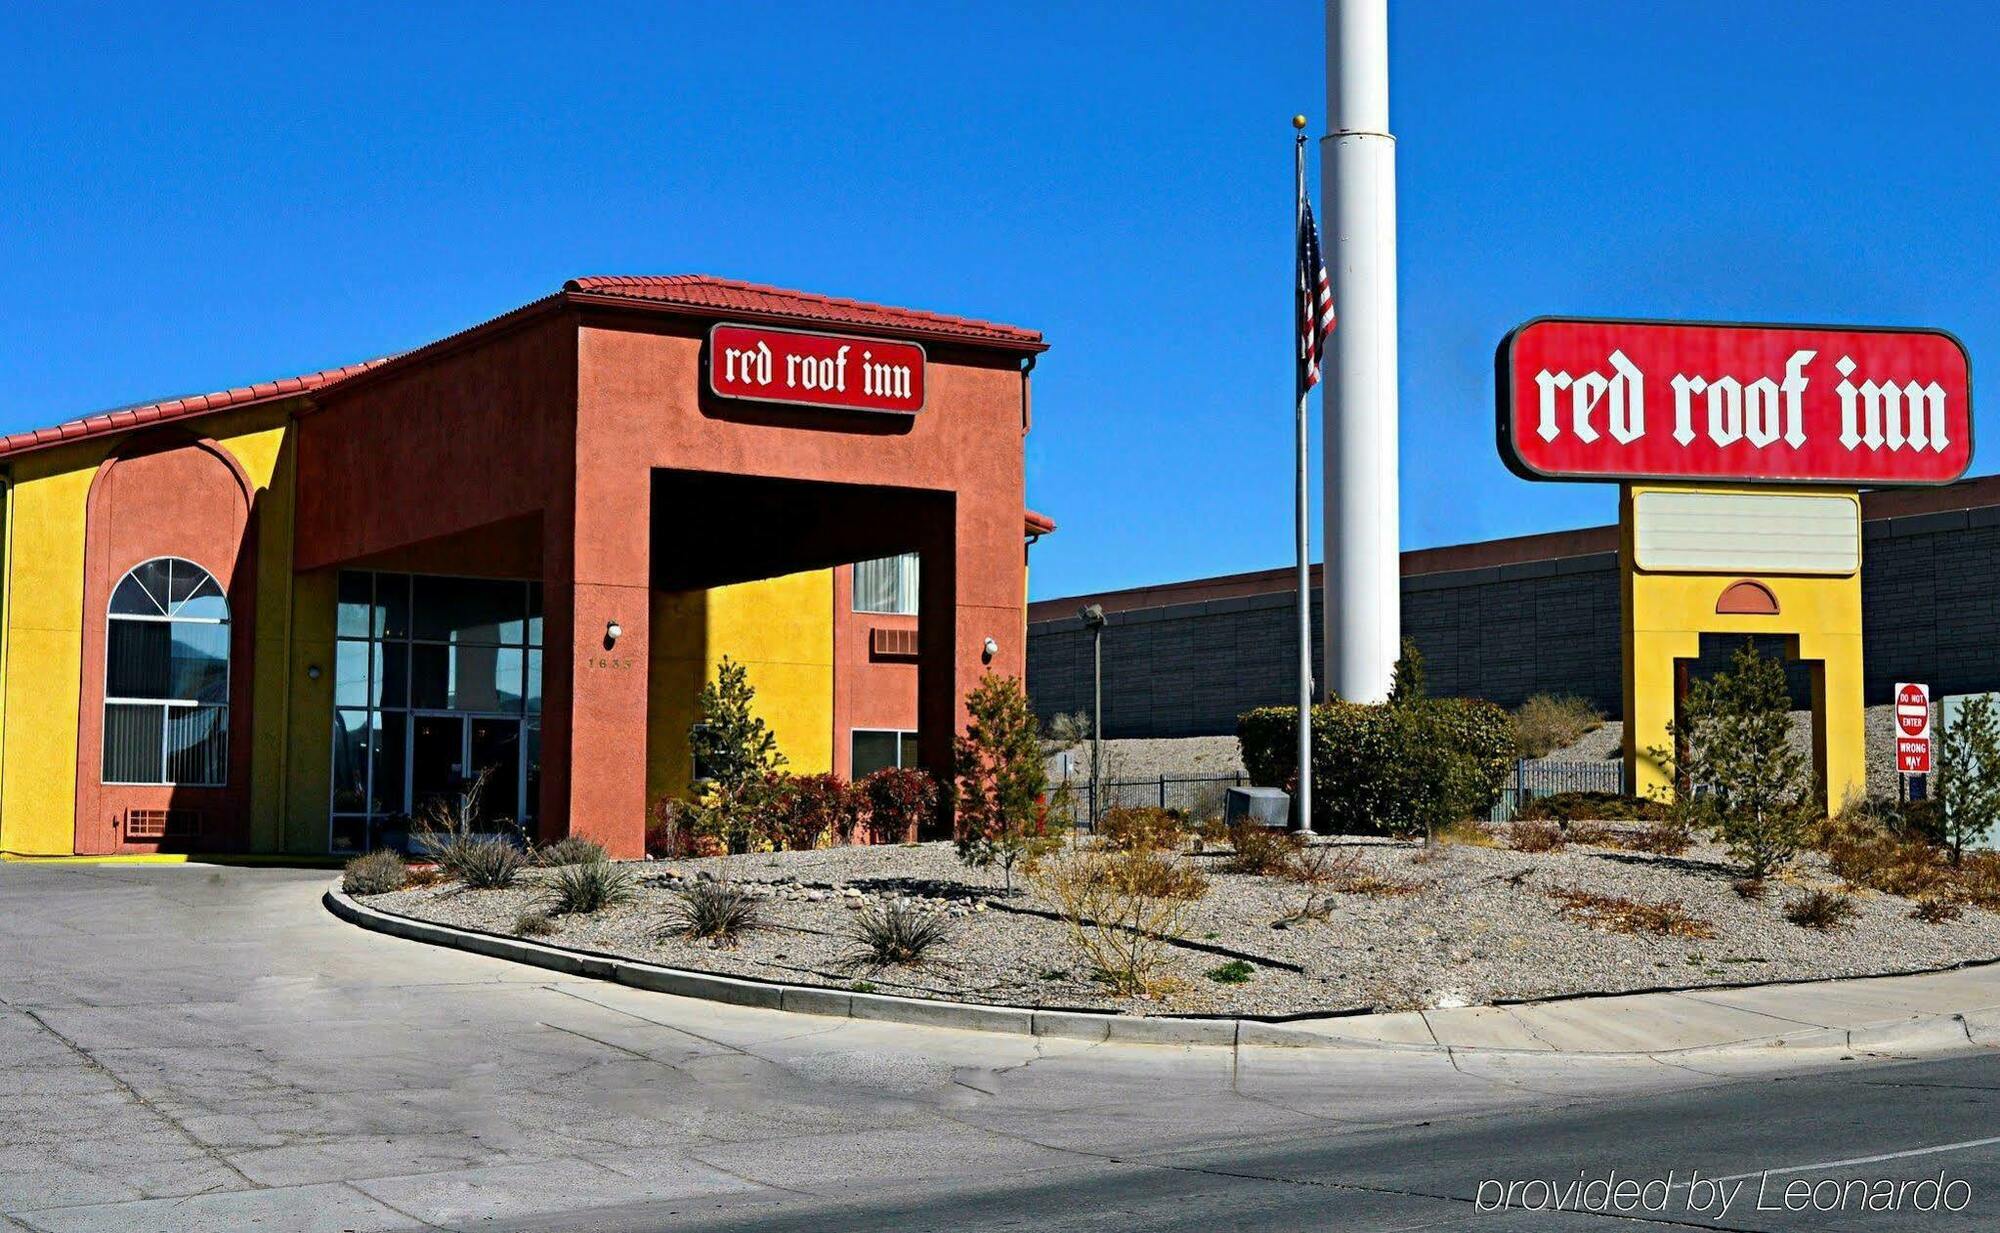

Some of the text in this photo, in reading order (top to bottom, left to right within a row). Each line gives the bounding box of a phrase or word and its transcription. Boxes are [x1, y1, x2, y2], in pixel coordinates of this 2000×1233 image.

[725, 340, 912, 399] red roof inn
[1534, 349, 1950, 454] red roof inn
[1900, 693, 1924, 703] DO NOT
[1902, 718, 1922, 727] ENTER
[1900, 743, 1926, 753] WRONG
[1905, 756, 1921, 767] WAY
